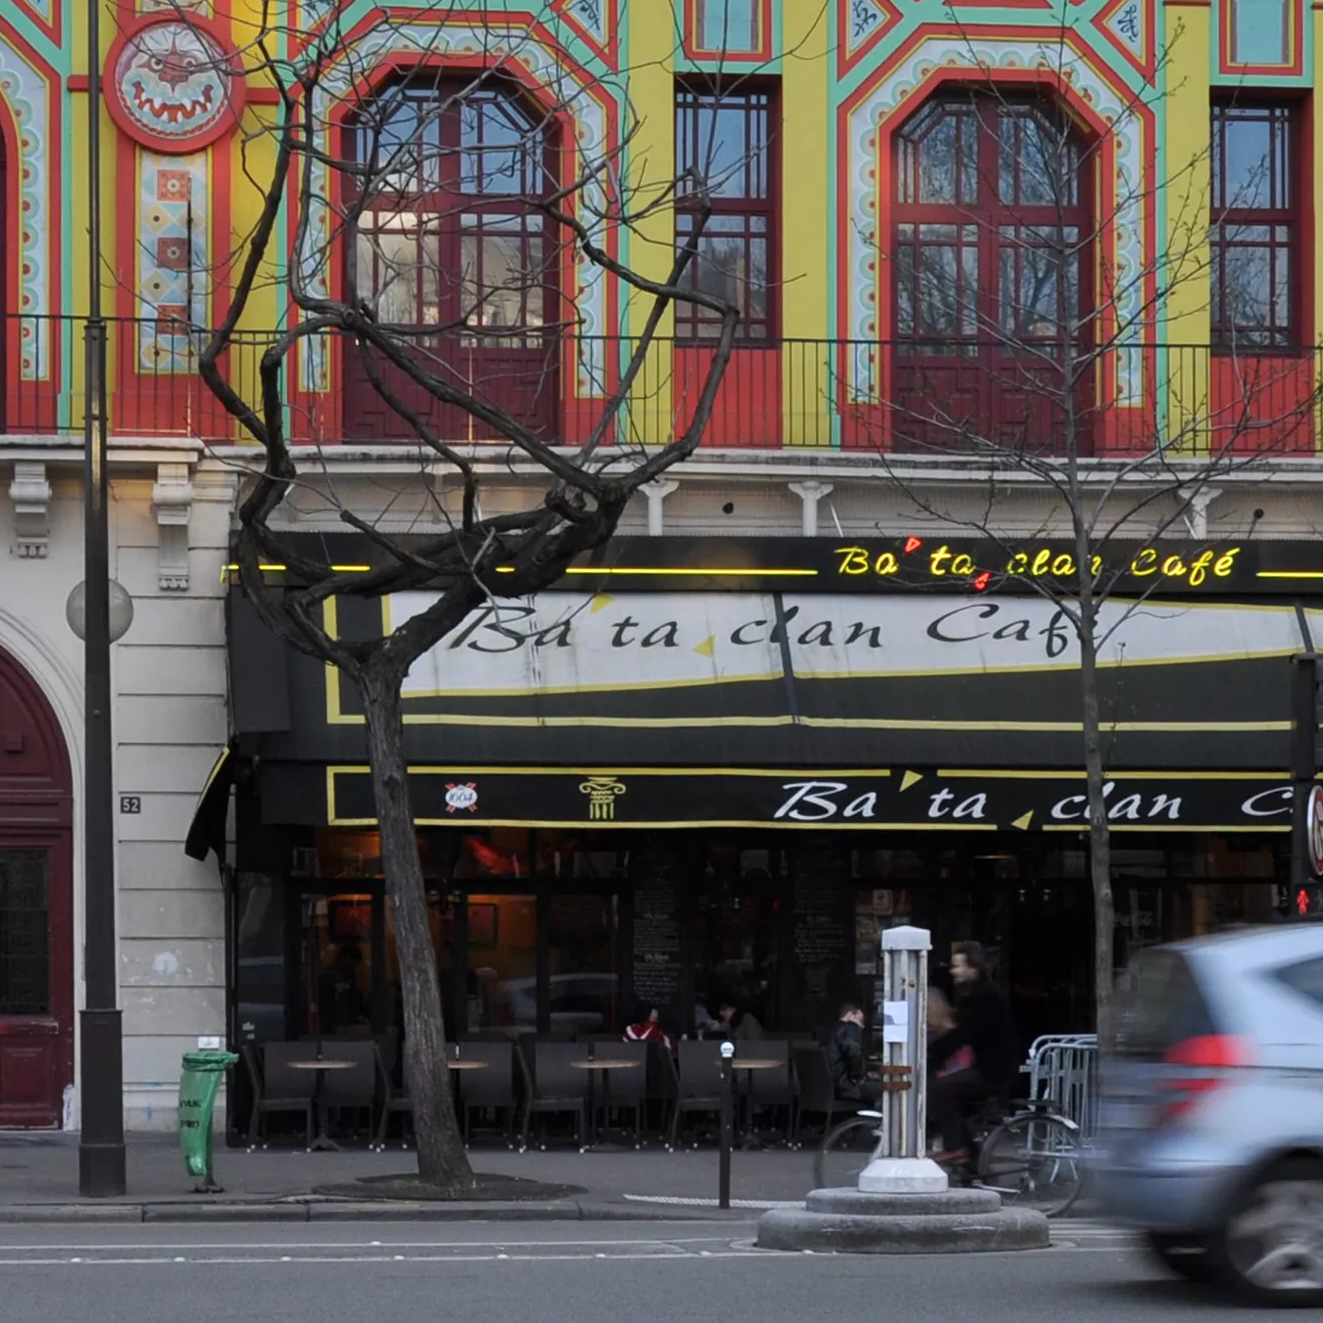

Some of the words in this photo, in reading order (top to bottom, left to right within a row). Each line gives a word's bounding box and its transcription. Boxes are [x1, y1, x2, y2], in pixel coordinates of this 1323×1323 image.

[833, 546, 898, 575] Ba
[929, 545, 976, 575] ta
[1131, 547, 1240, 587] Café
[611, 615, 680, 648] ta
[773, 780, 877, 821] Ba
[927, 786, 988, 819] ta
